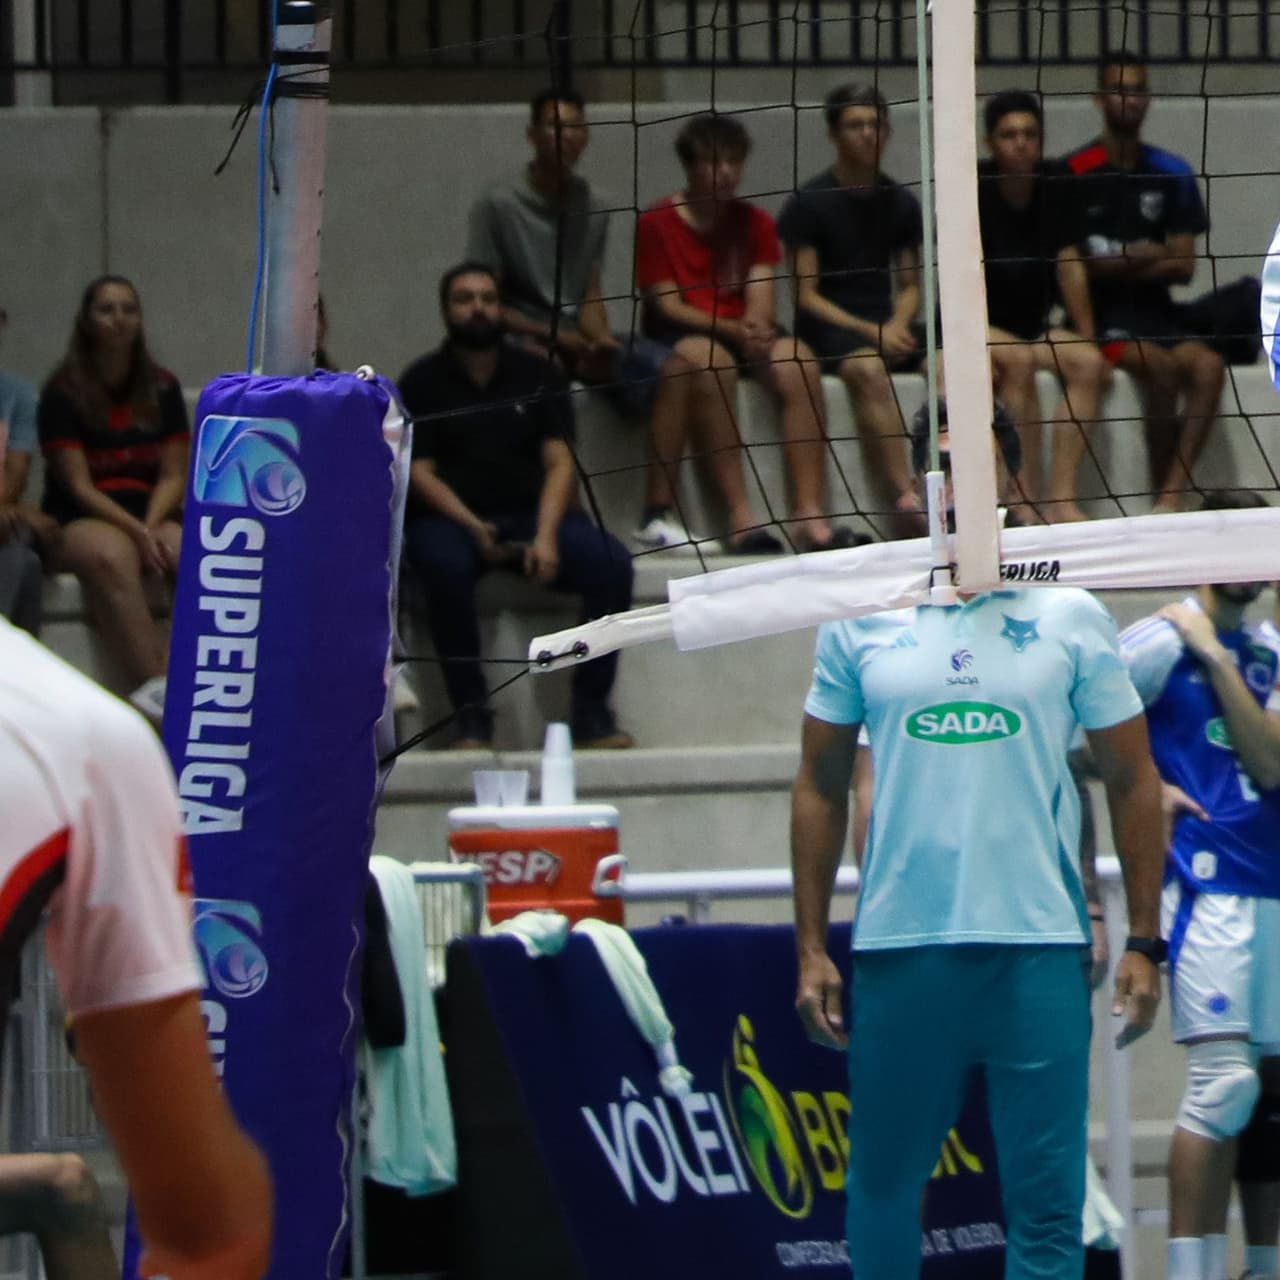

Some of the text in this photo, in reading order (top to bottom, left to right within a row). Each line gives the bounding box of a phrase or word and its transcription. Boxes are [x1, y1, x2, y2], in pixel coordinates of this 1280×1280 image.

[179, 516, 266, 838] SUPERLIGA
[946, 675, 980, 687] SADA
[914, 710, 1011, 737] SADA
[580, 1076, 750, 1206] VÔLEI
